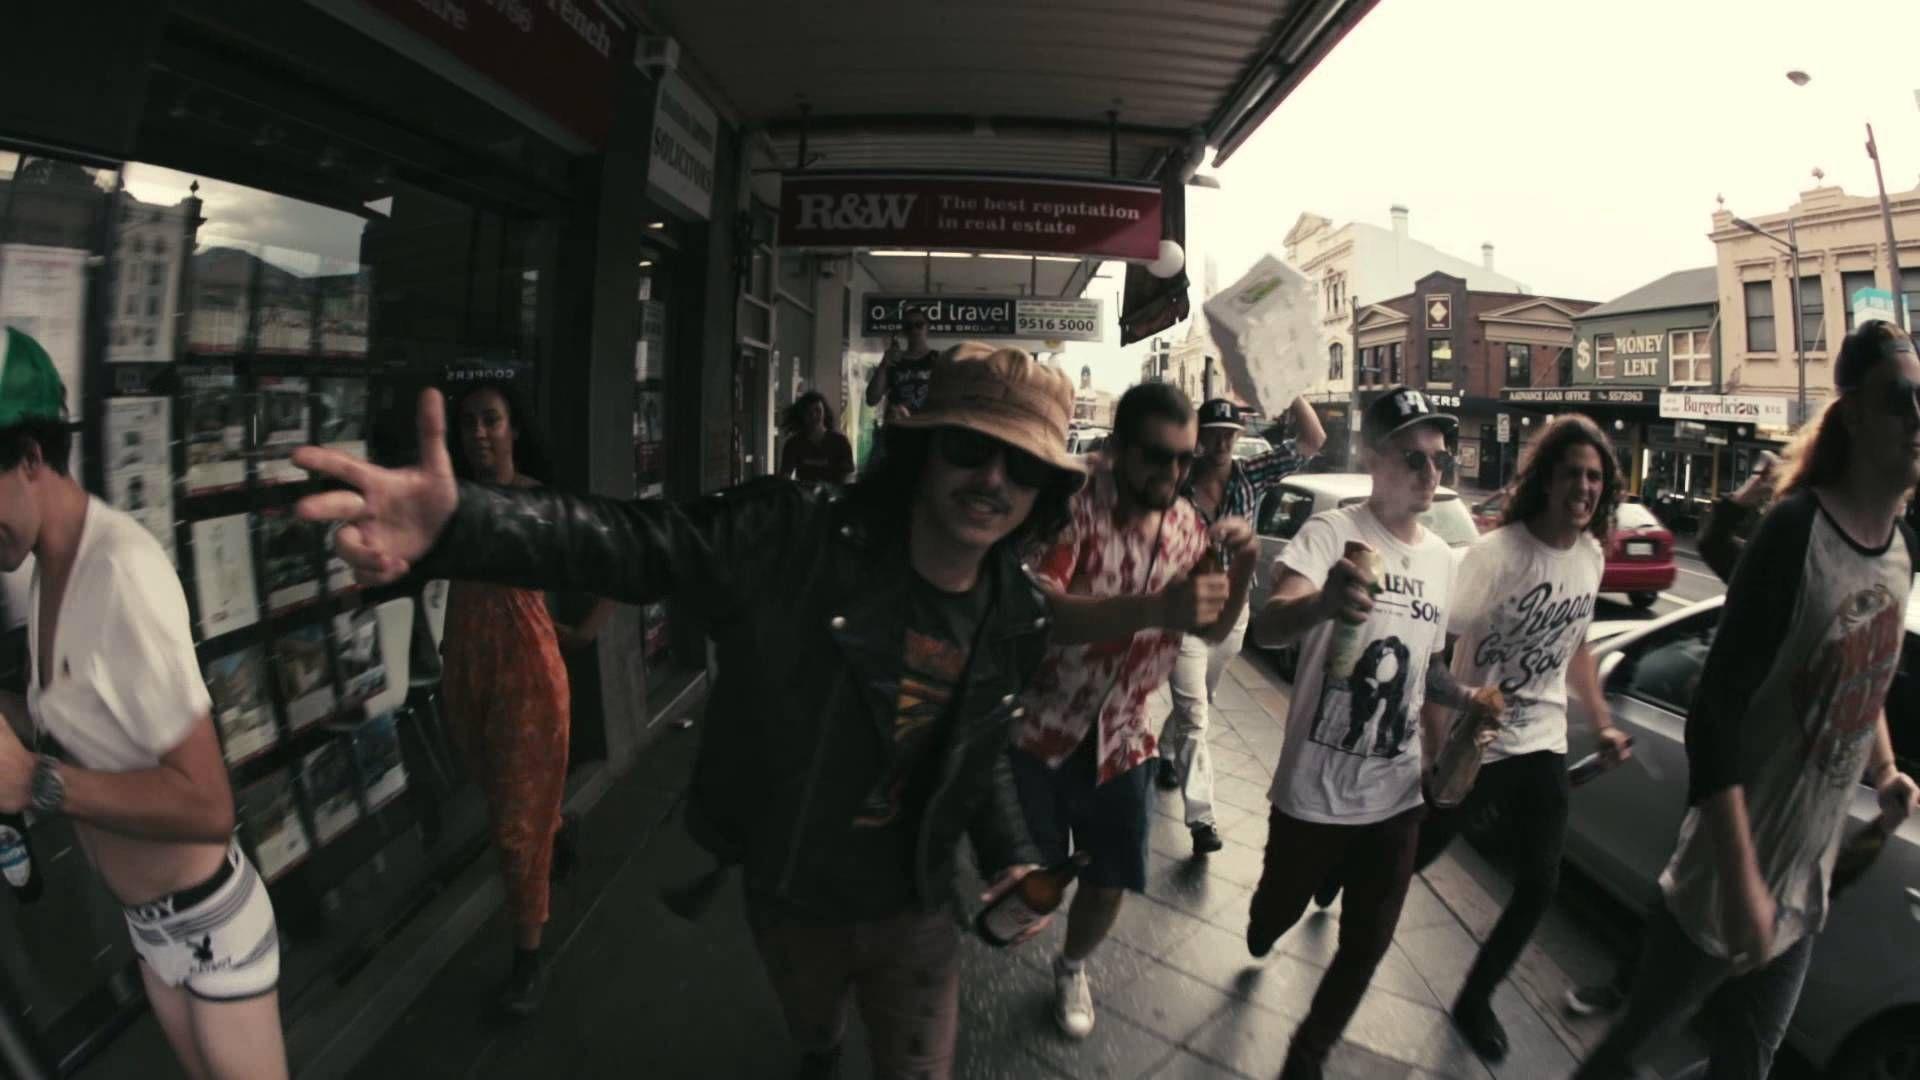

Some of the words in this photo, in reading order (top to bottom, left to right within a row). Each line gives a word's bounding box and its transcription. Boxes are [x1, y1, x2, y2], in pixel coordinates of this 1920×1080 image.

[795, 193, 919, 230] R&W
[939, 195, 977, 210] The
[985, 198, 1025, 212] best
[1032, 201, 1141, 220] reputation
[937, 215, 958, 229] in
[964, 216, 1006, 231] real
[1012, 219, 1076, 234] estate
[950, 301, 1010, 322] travel
[1018, 318, 1055, 331] 9516
[1058, 318, 1095, 332] 5000
[1616, 335, 1664, 354] MONEY
[1624, 358, 1658, 376] LENT
[1424, 389, 1466, 408] ERS'
[1565, 391, 1591, 401] OFFICE
[1683, 395, 1760, 416] Burgerlicious
[1384, 573, 1425, 598] LENT
